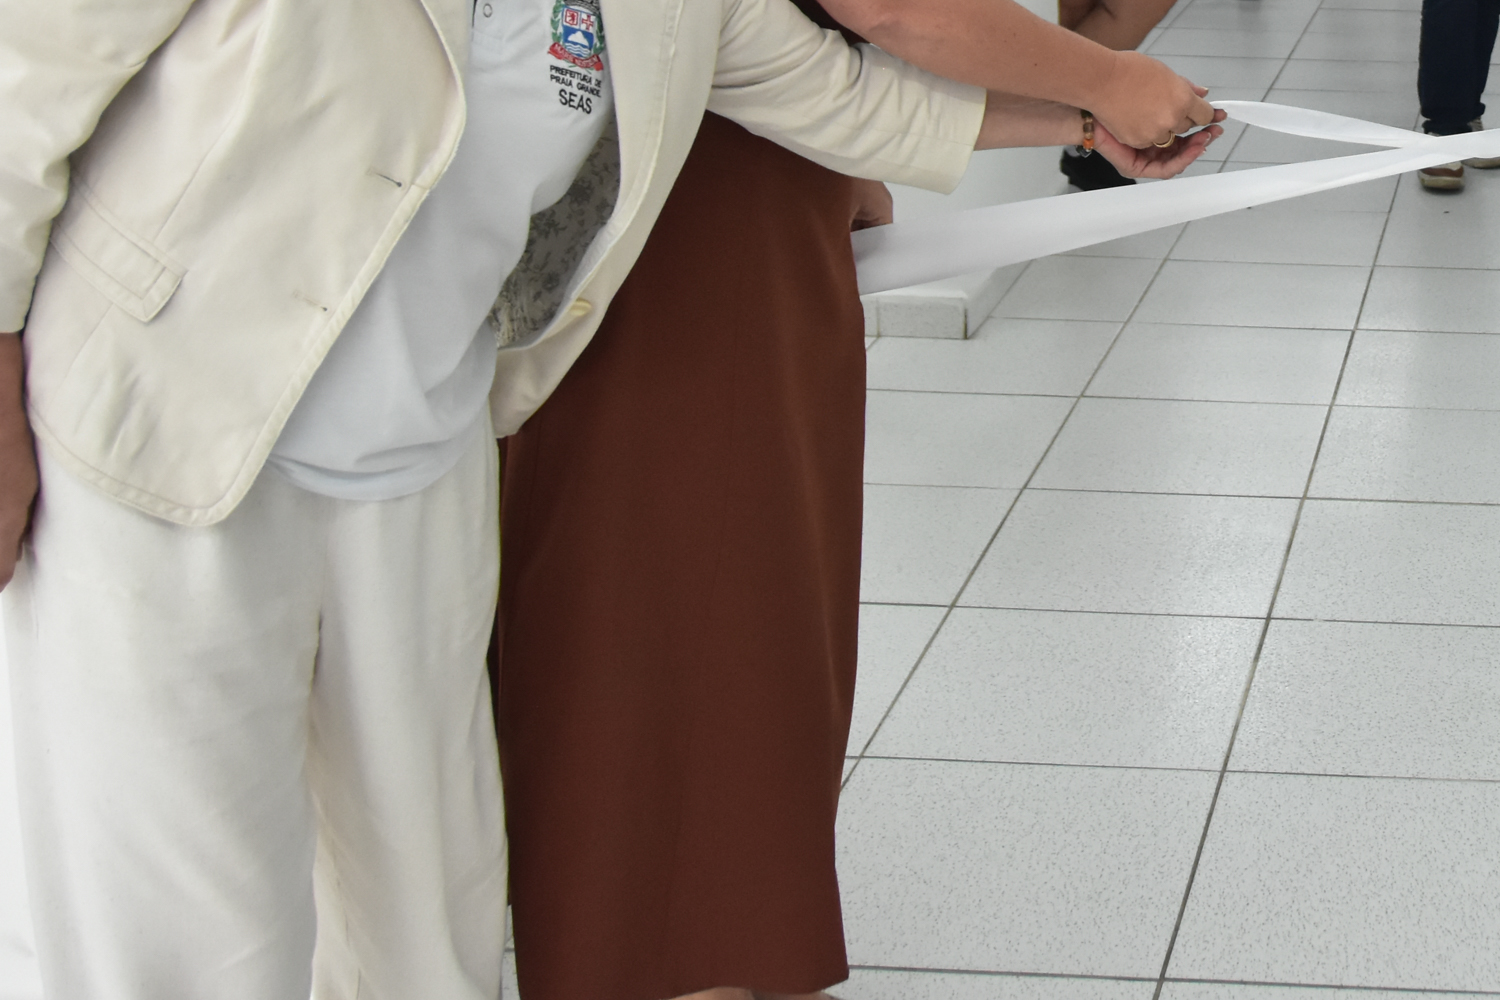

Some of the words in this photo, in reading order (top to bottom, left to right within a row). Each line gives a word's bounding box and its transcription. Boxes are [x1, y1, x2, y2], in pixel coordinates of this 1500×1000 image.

[550, 64, 592, 85] PREFEITURA
[594, 78, 602, 88] DE
[550, 74, 573, 89] PRAIA
[576, 82, 602, 98] GRANDE
[558, 88, 593, 115] SEAS
